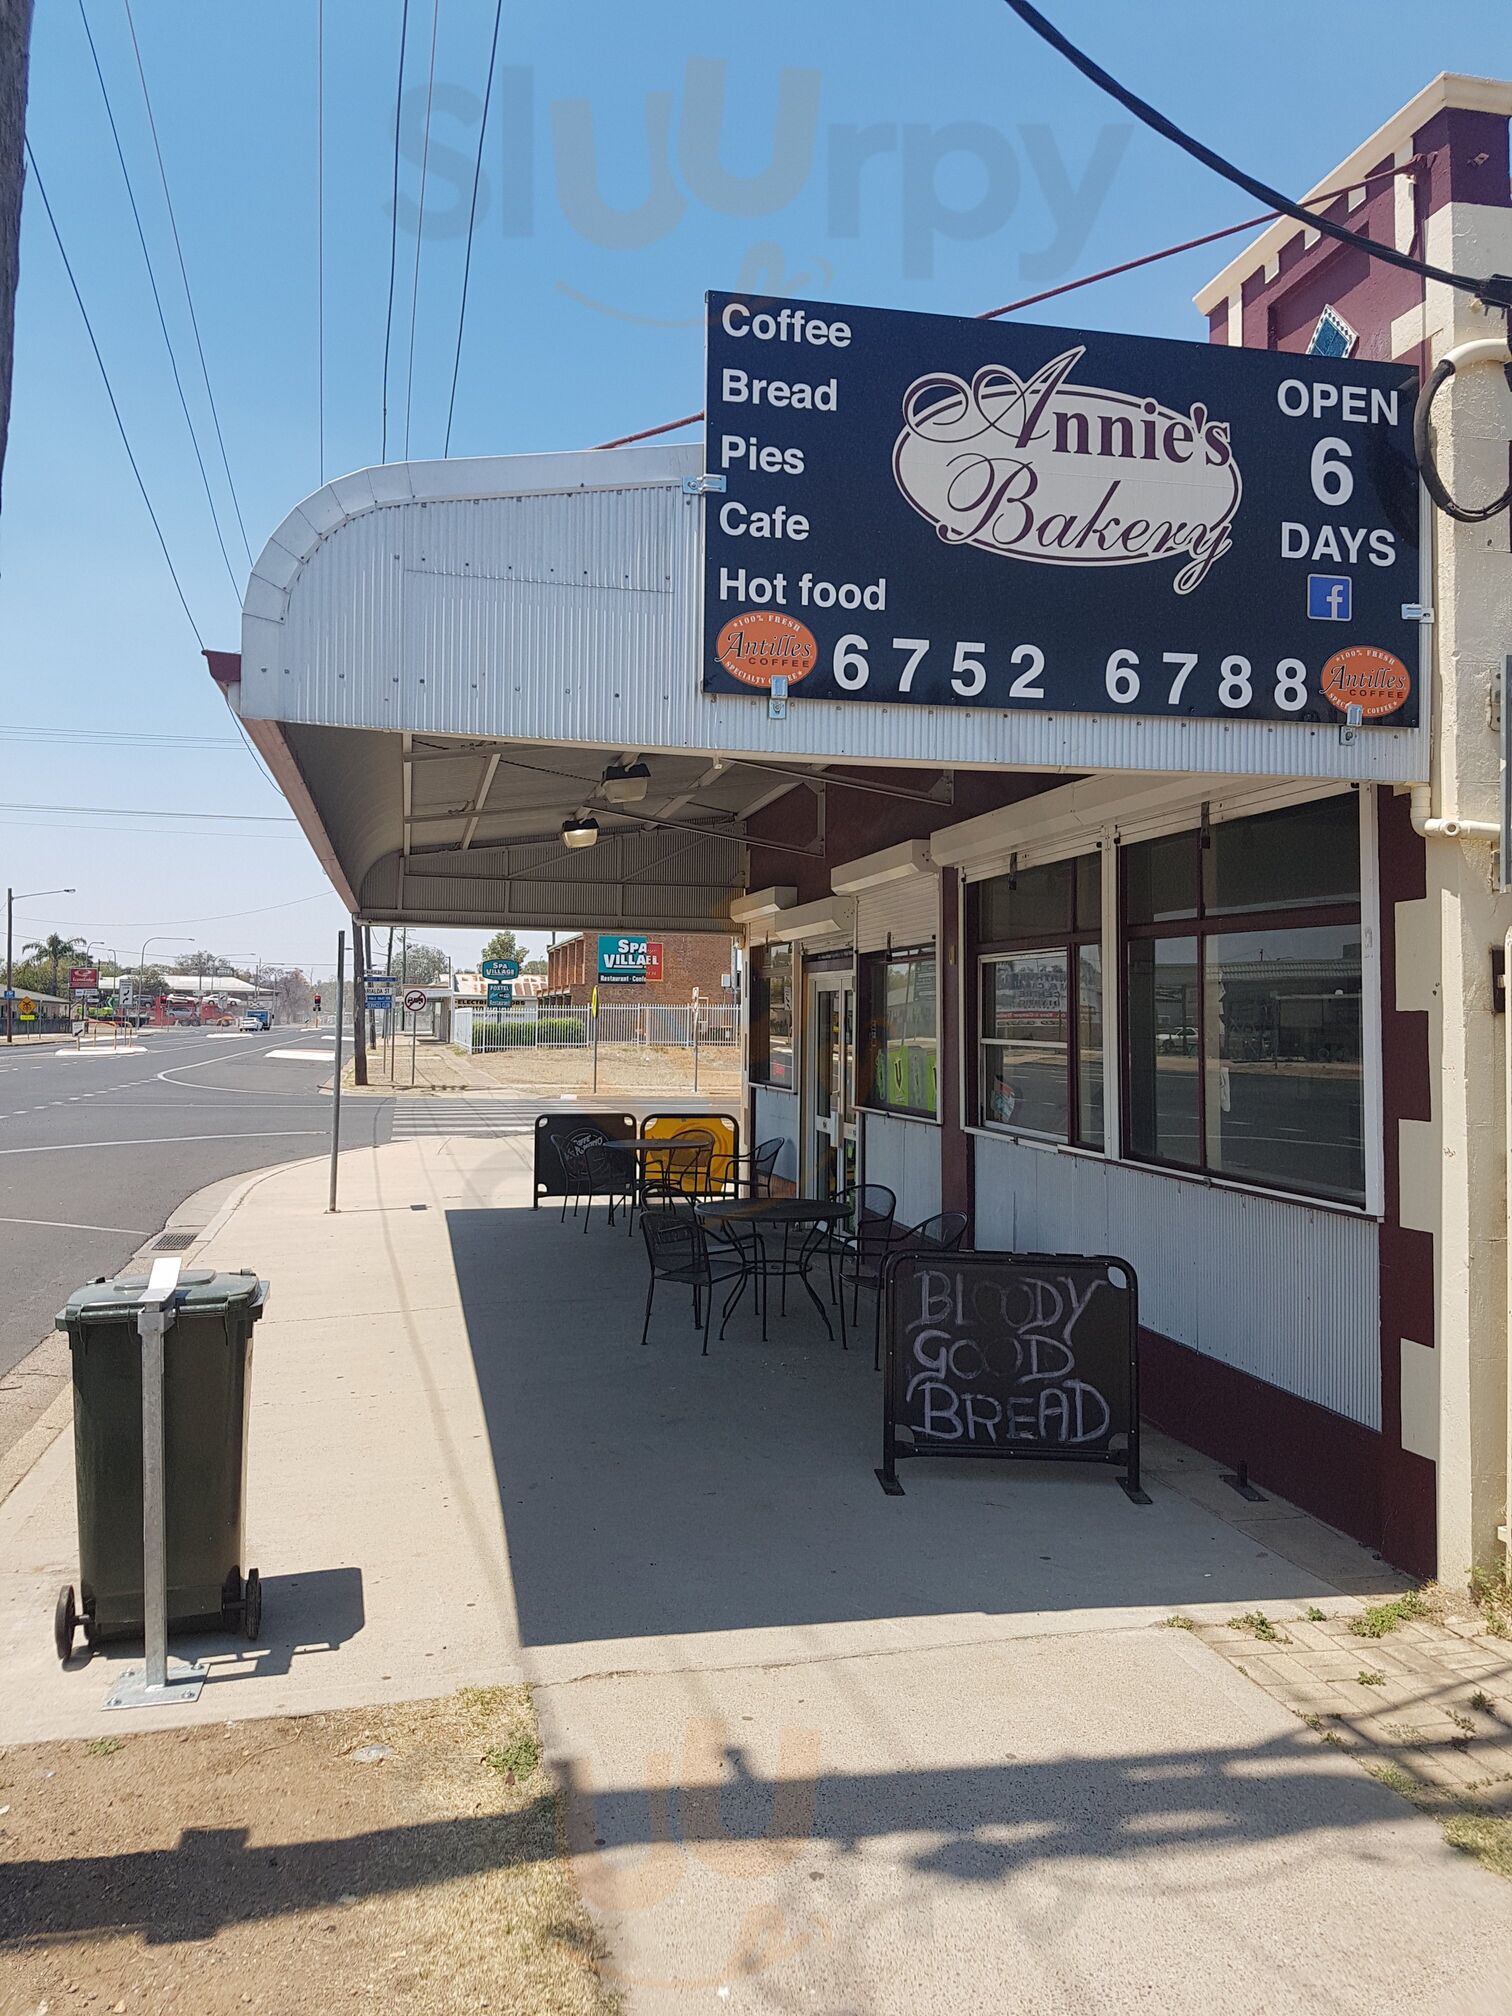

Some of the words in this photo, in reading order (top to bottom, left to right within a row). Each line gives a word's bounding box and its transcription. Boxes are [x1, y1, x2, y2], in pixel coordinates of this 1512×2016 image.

[721, 303, 852, 348] Coffee
[721, 368, 838, 412] Bread
[904, 345, 1231, 466] Annie's
[1277, 379, 1398, 426] OPEN
[721, 435, 805, 475] Pies
[1310, 436, 1354, 506] 6
[719, 501, 810, 541] Cafe
[937, 453, 1231, 593] Bakery
[1281, 521, 1396, 567] DAYS
[719, 567, 787, 605] Hot
[798, 573, 886, 611] food
[768, 615, 801, 632] FRESH
[714, 630, 814, 662] Antilles
[748, 657, 810, 668] COFFEE
[1366, 650, 1396, 666] FRESH
[726, 661, 766, 685] SPECIALTY
[1318, 663, 1406, 695] Antilles
[1349, 689, 1404, 699] COFFEE
[485, 968, 515, 976] VILLAGE
[906, 1329, 1075, 1402] GOOD
[910, 1379, 1111, 1443] BREAD
